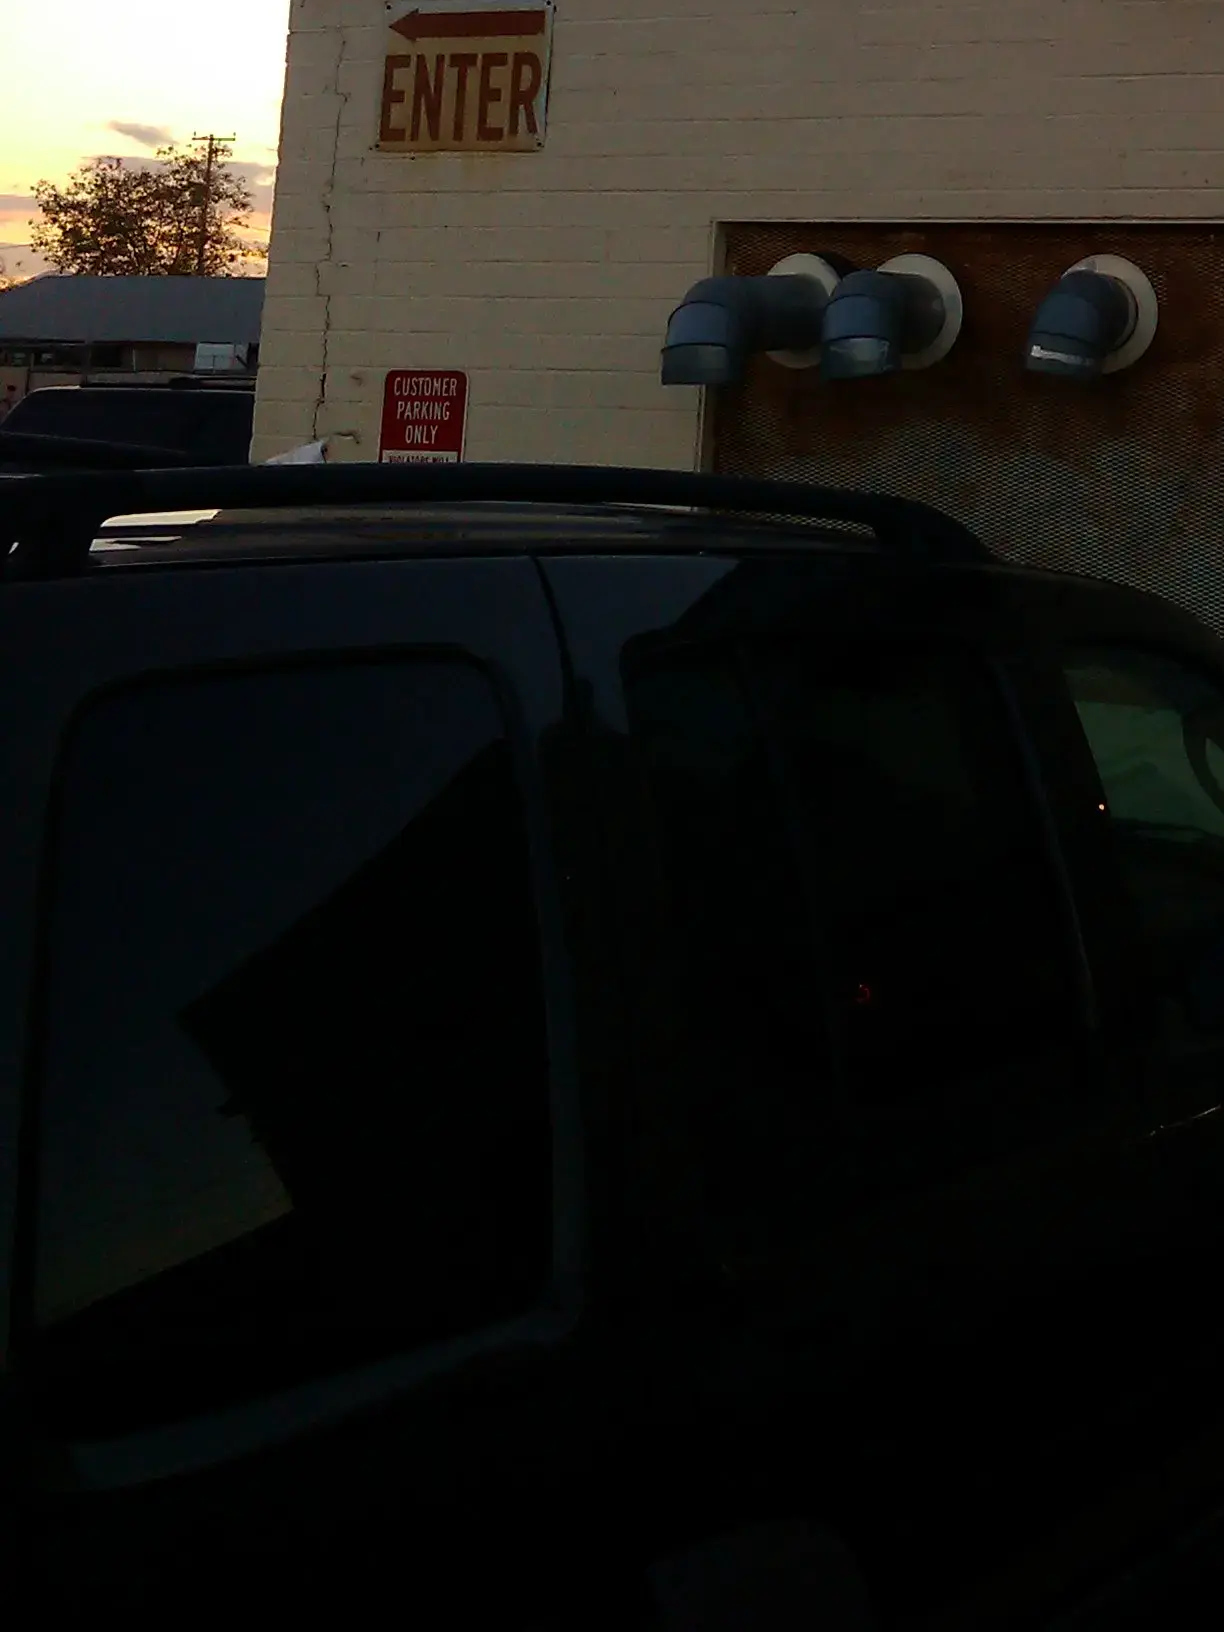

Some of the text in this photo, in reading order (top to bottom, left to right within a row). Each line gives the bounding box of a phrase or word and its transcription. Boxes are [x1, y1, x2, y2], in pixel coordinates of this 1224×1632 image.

[379, 52, 543, 142] ENTER
[393, 376, 458, 397] CUSTOMER
[396, 400, 451, 421] PARKING
[404, 424, 439, 445] ONLY
